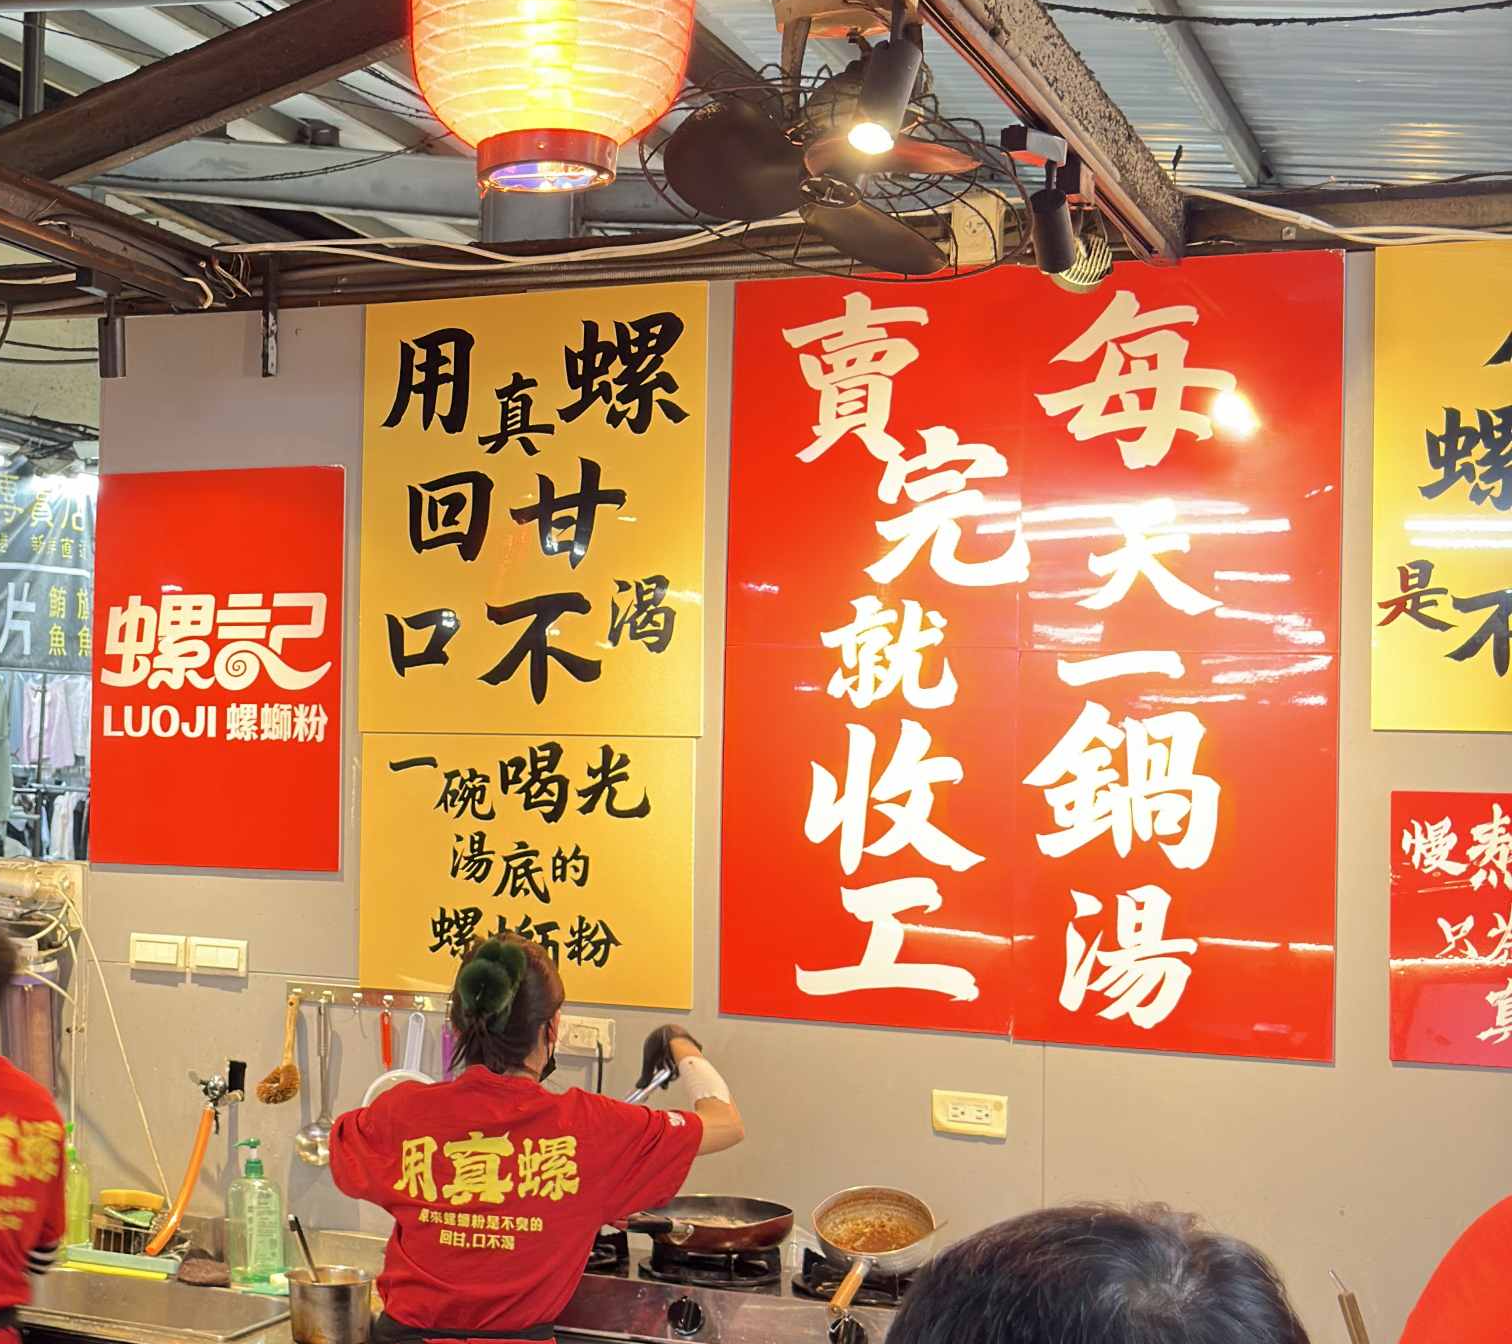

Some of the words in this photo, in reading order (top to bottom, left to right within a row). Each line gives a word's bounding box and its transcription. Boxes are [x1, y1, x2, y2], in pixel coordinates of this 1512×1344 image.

[381, 311, 689, 456] 用真螺
[407, 457, 627, 569] 回甘
[100, 592, 332, 691] 螺記
[385, 574, 678, 705] 口不渴
[781, 291, 1030, 1003] 賣完就收工
[1024, 290, 1237, 1030] 每天一鍋湯
[103, 705, 217, 738] LUOJI
[226, 703, 329, 743] 螺螄粉
[389, 741, 651, 824] 一碗喝光
[450, 830, 590, 904] 湯底的
[393, 1131, 580, 1205] 用真螺
